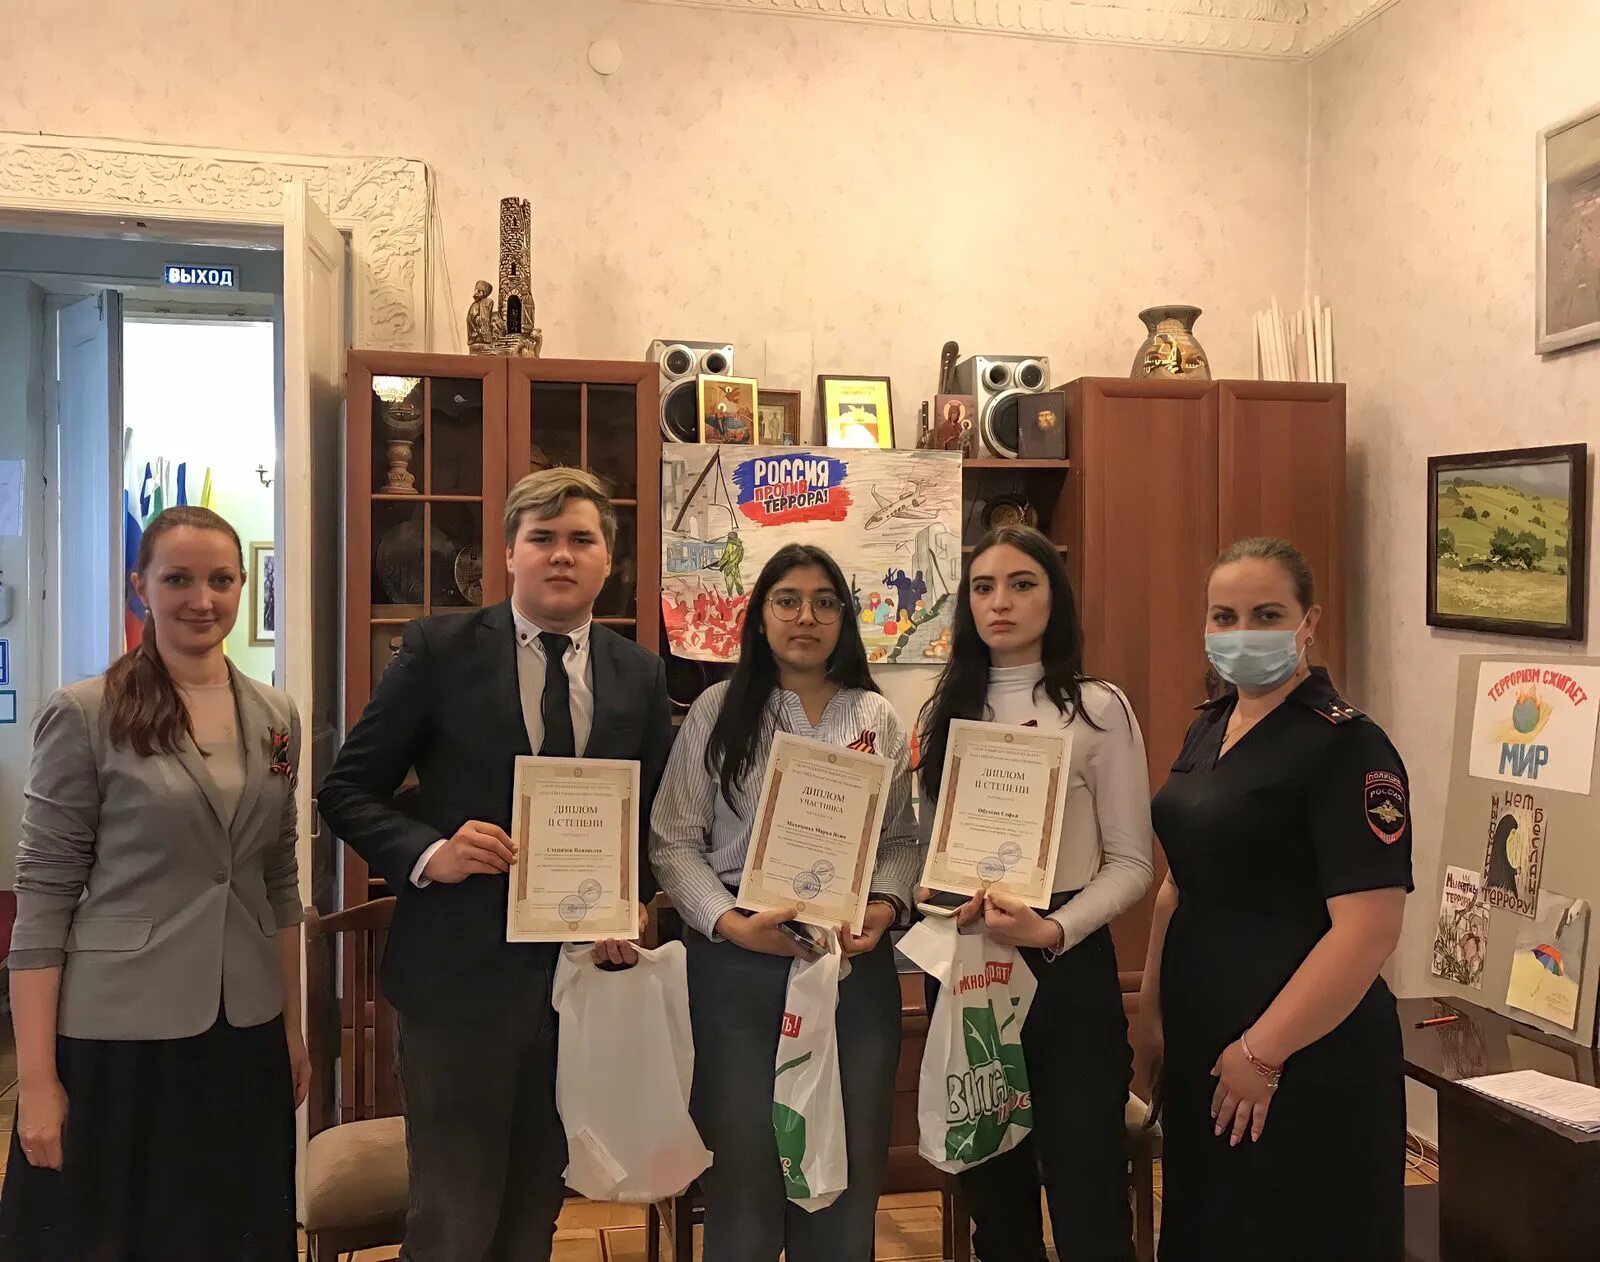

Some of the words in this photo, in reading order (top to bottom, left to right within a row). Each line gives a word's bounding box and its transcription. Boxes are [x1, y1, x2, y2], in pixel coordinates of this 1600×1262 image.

[168, 267, 233, 287] ВЫХОД
[754, 458, 829, 487] РОССИЯ
[754, 479, 808, 502] ПРОТИВ
[763, 488, 829, 514] ТЕРРОРА!
[1488, 668, 1541, 702] ТЕРРОРИЗМ
[1543, 670, 1588, 706] СЖИГАЕТ
[1498, 742, 1549, 780] МИР
[981, 768, 1025, 780] ДИПЛОМ
[802, 786, 845, 803] ДИПЛОМ
[983, 781, 1029, 794] СТЕПЕНИ
[1370, 788, 1403, 804] РОССИЯ
[553, 805, 598, 814] ДИПЛОМ
[800, 797, 844, 814] УЧАСТНИКА
[557, 818, 603, 828] СТЕПЕНИ
